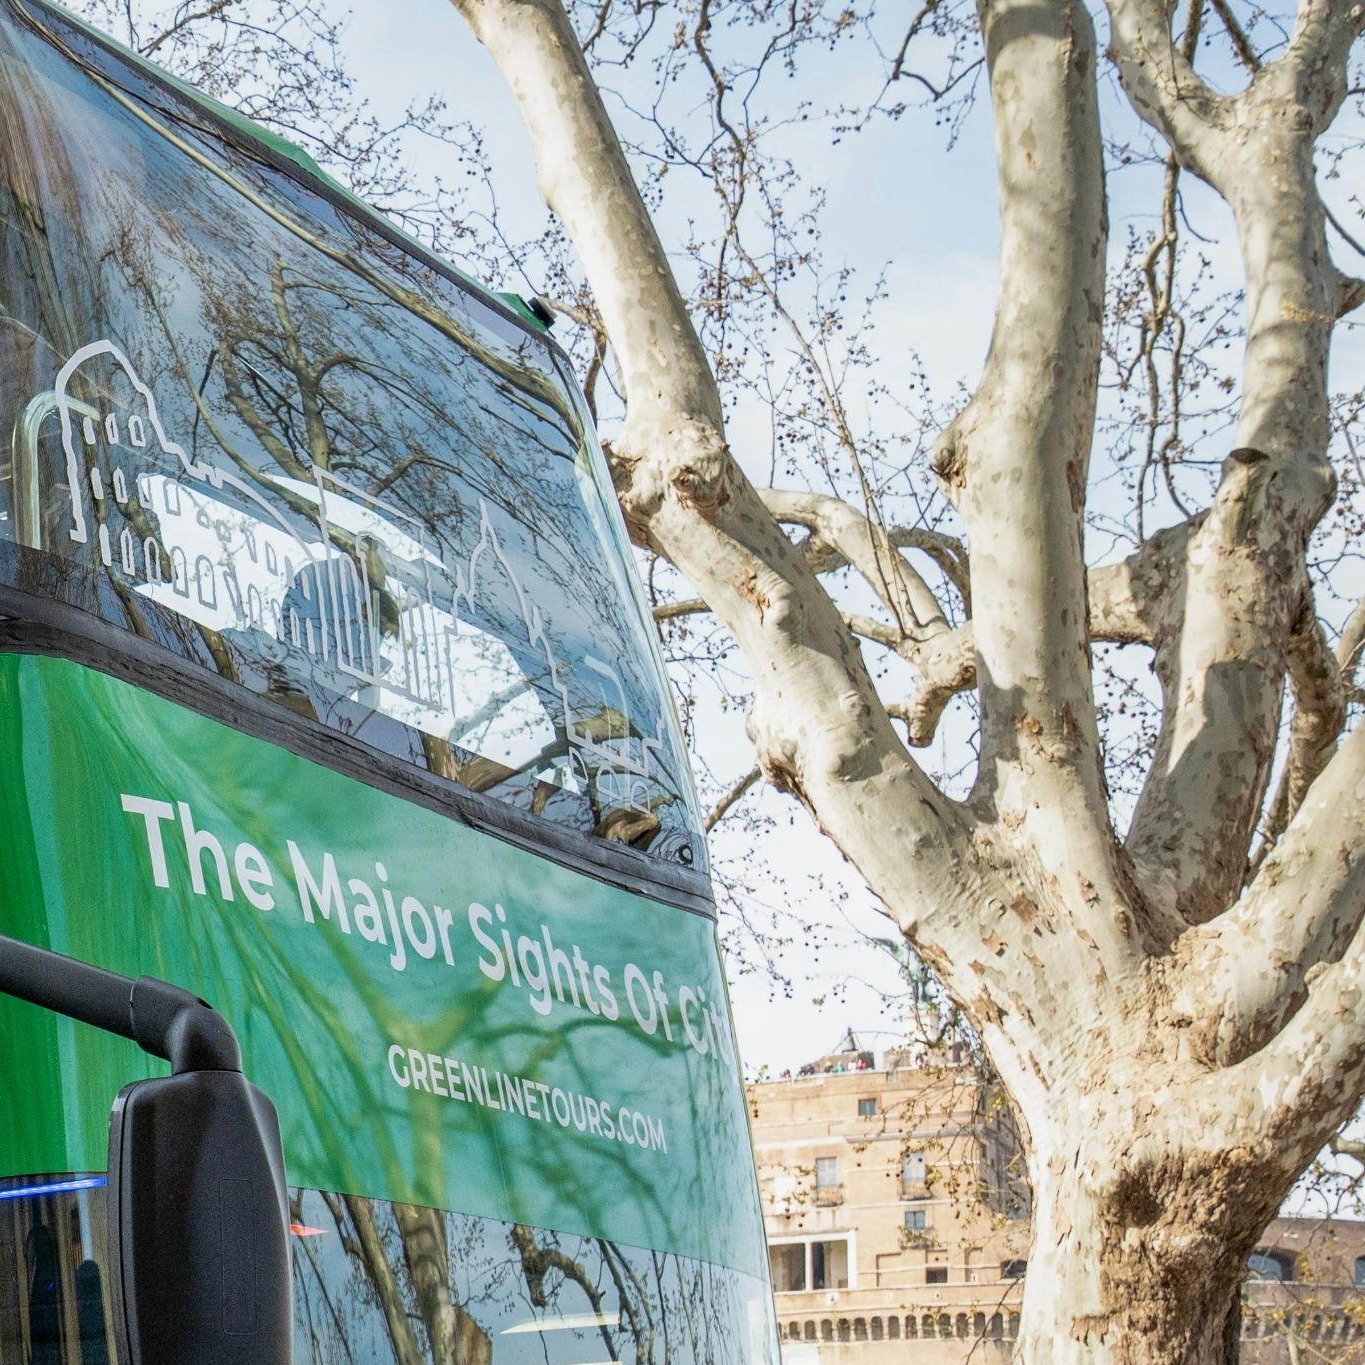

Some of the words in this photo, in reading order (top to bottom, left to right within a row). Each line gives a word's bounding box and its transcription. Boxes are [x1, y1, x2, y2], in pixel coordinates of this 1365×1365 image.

[121, 794, 275, 911] The
[287, 840, 455, 972] Major
[469, 903, 619, 1021] Sights
[624, 963, 673, 1042] Of
[388, 1044, 667, 1153] GREENLINETOURS.COM
